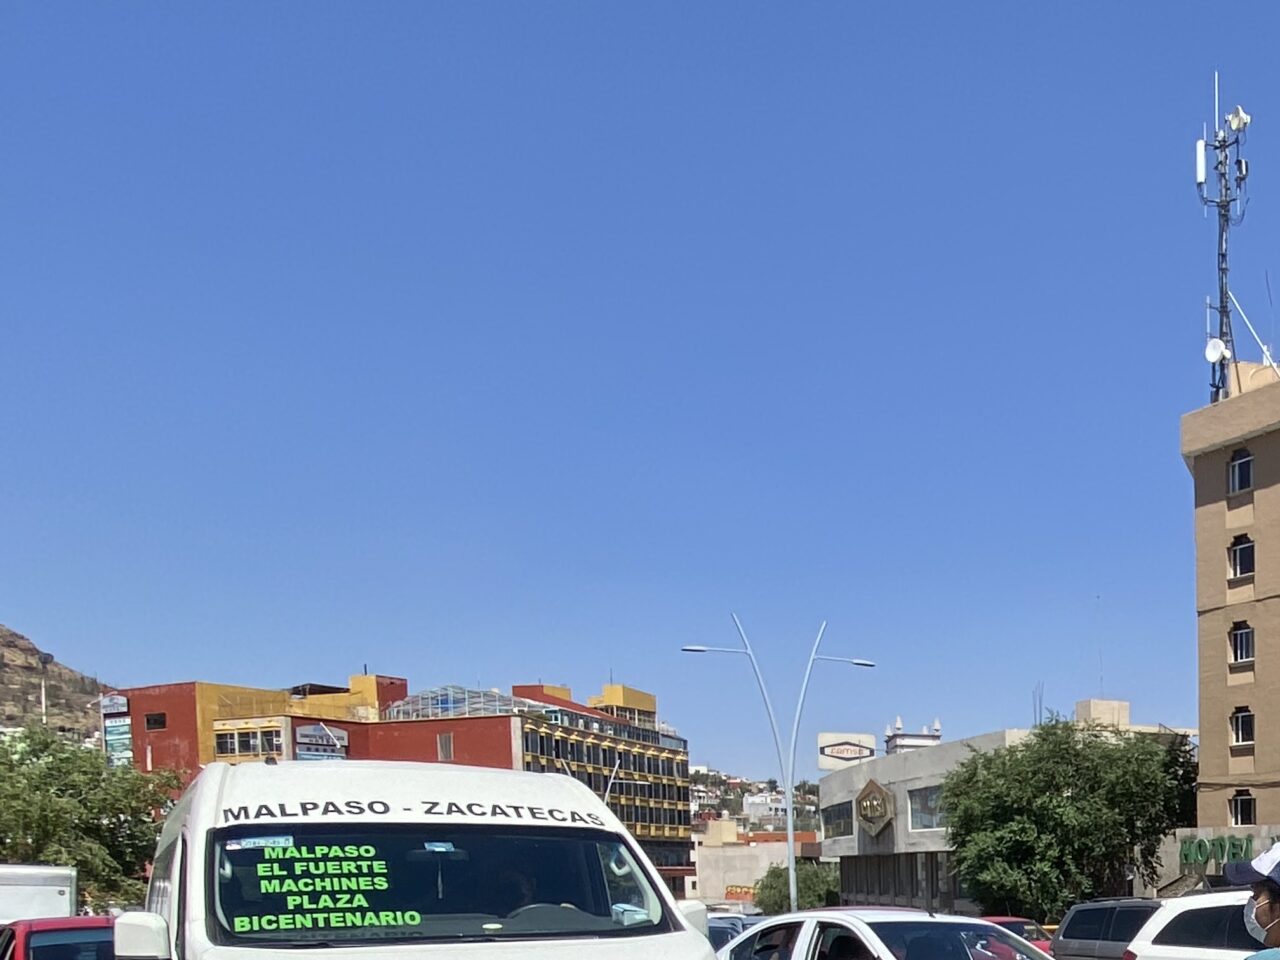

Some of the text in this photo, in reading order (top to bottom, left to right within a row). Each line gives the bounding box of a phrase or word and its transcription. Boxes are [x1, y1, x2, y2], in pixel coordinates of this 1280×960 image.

[222, 800, 391, 824] MALPASO
[424, 800, 606, 827] ZACATECAS
[264, 845, 377, 860] MALPASO
[257, 860, 388, 877] EL FUERTE
[260, 877, 390, 894] MACHINES
[286, 894, 369, 910] PLAZA
[233, 911, 422, 933] BICENTENARIO
